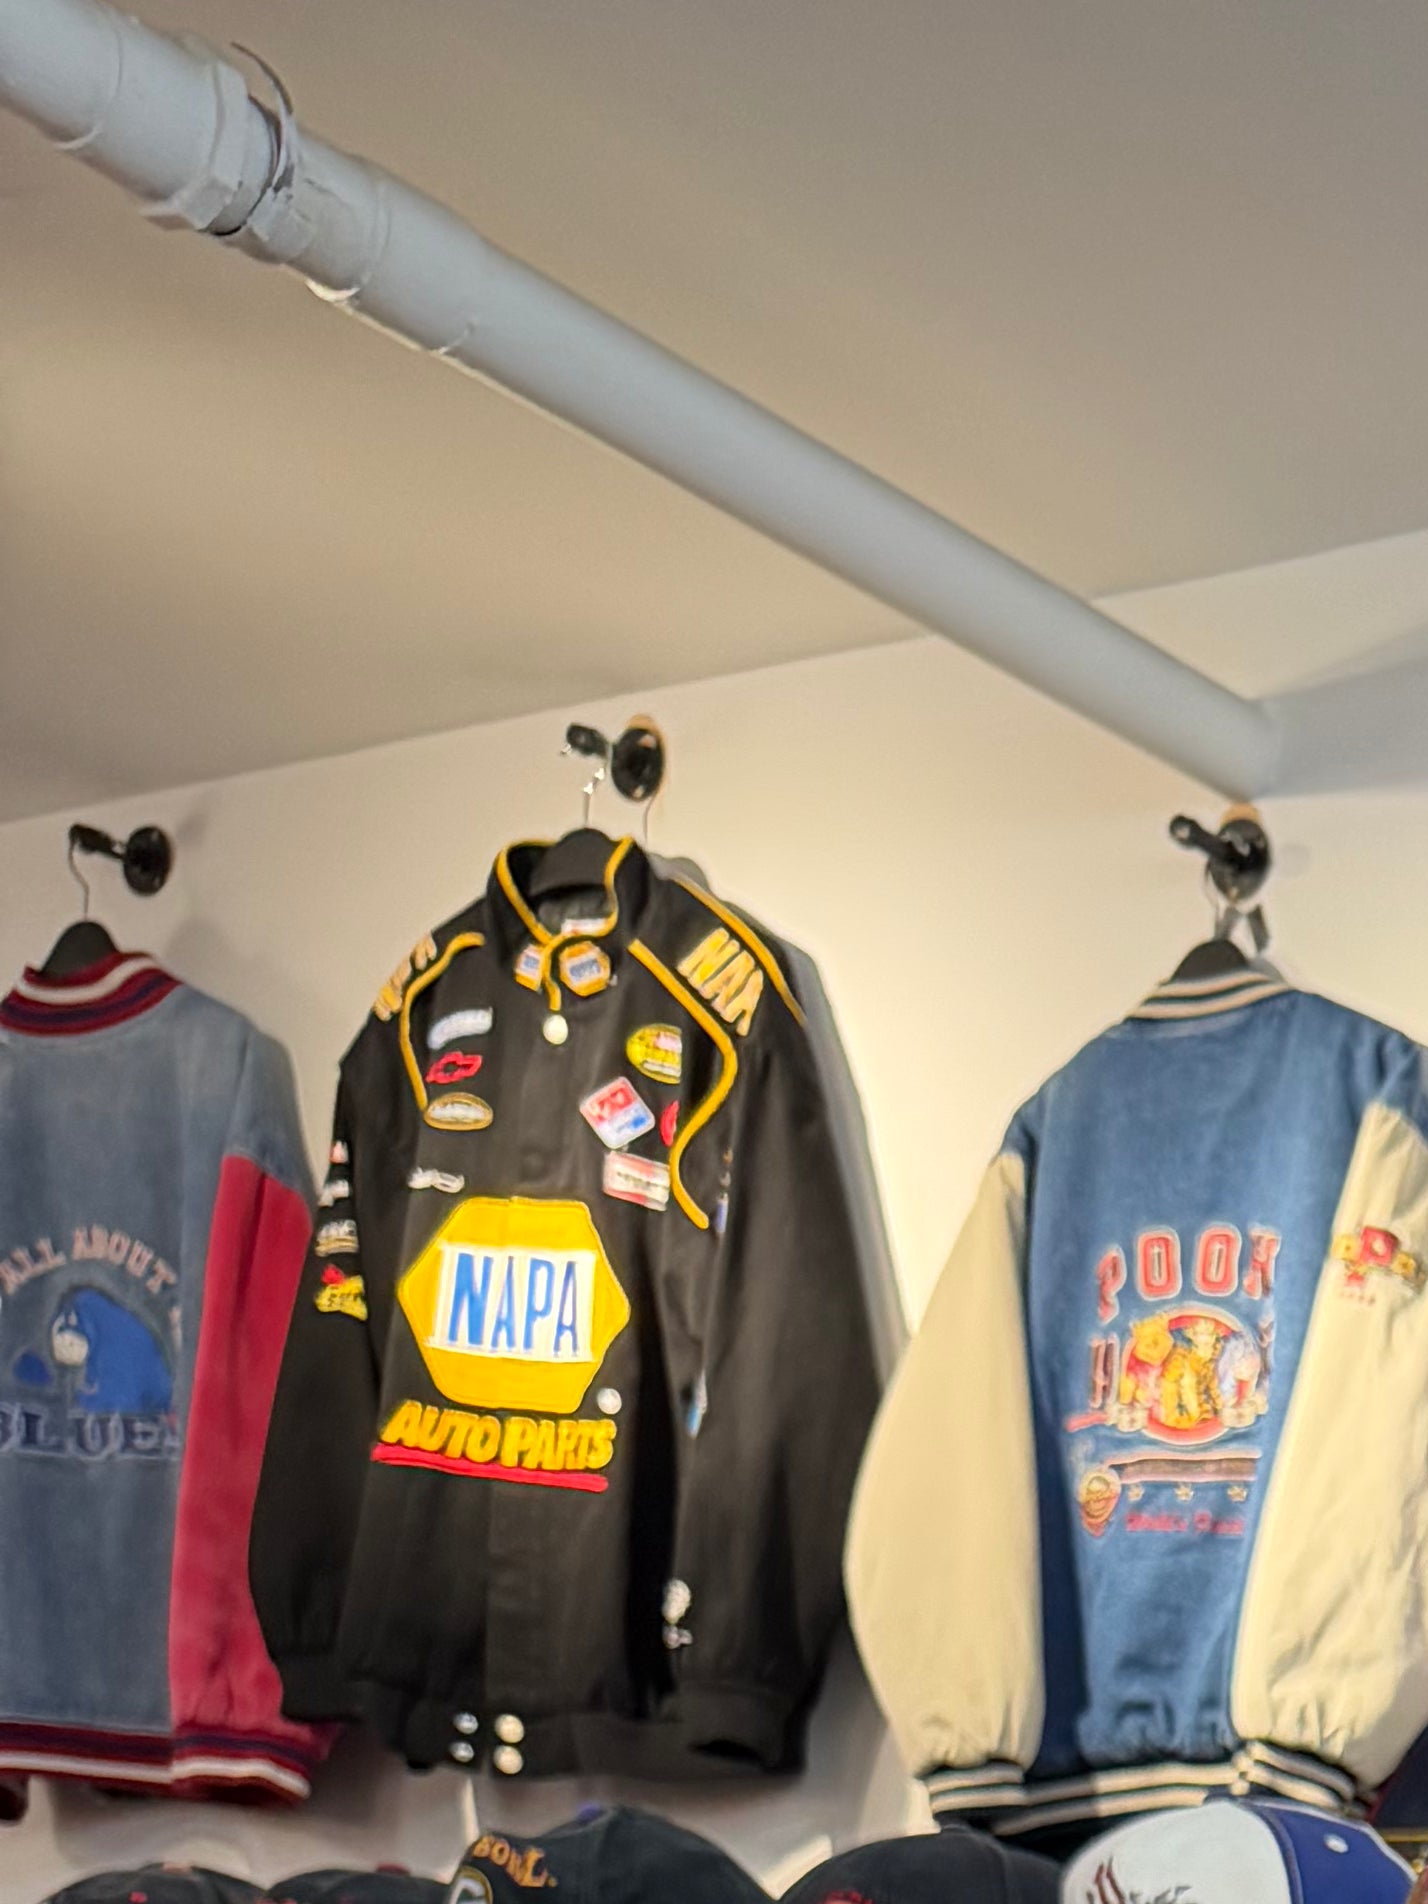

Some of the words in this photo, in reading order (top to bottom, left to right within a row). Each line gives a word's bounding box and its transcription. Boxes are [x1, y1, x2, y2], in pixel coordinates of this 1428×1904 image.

[447, 1252, 580, 1358] NAPA
[380, 1401, 501, 1464] AUTO
[501, 1416, 617, 1470] PARTS
